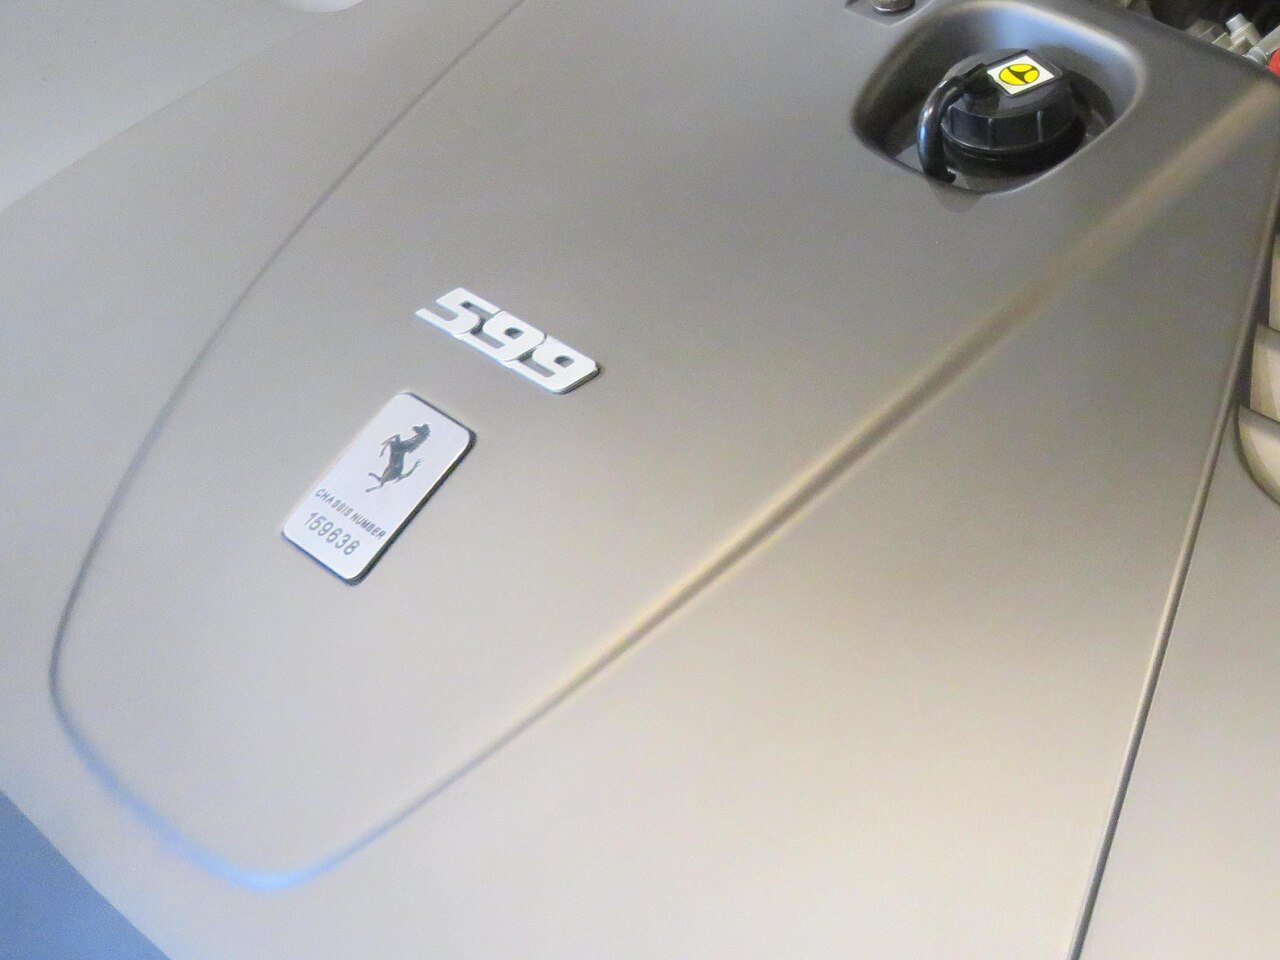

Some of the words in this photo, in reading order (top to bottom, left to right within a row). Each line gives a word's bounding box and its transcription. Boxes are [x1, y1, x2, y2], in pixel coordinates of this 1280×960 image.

[414, 287, 600, 393] 599
[304, 511, 359, 556] 159638
[314, 486, 353, 516] CHASSIS
[350, 510, 387, 539] NUMBER
